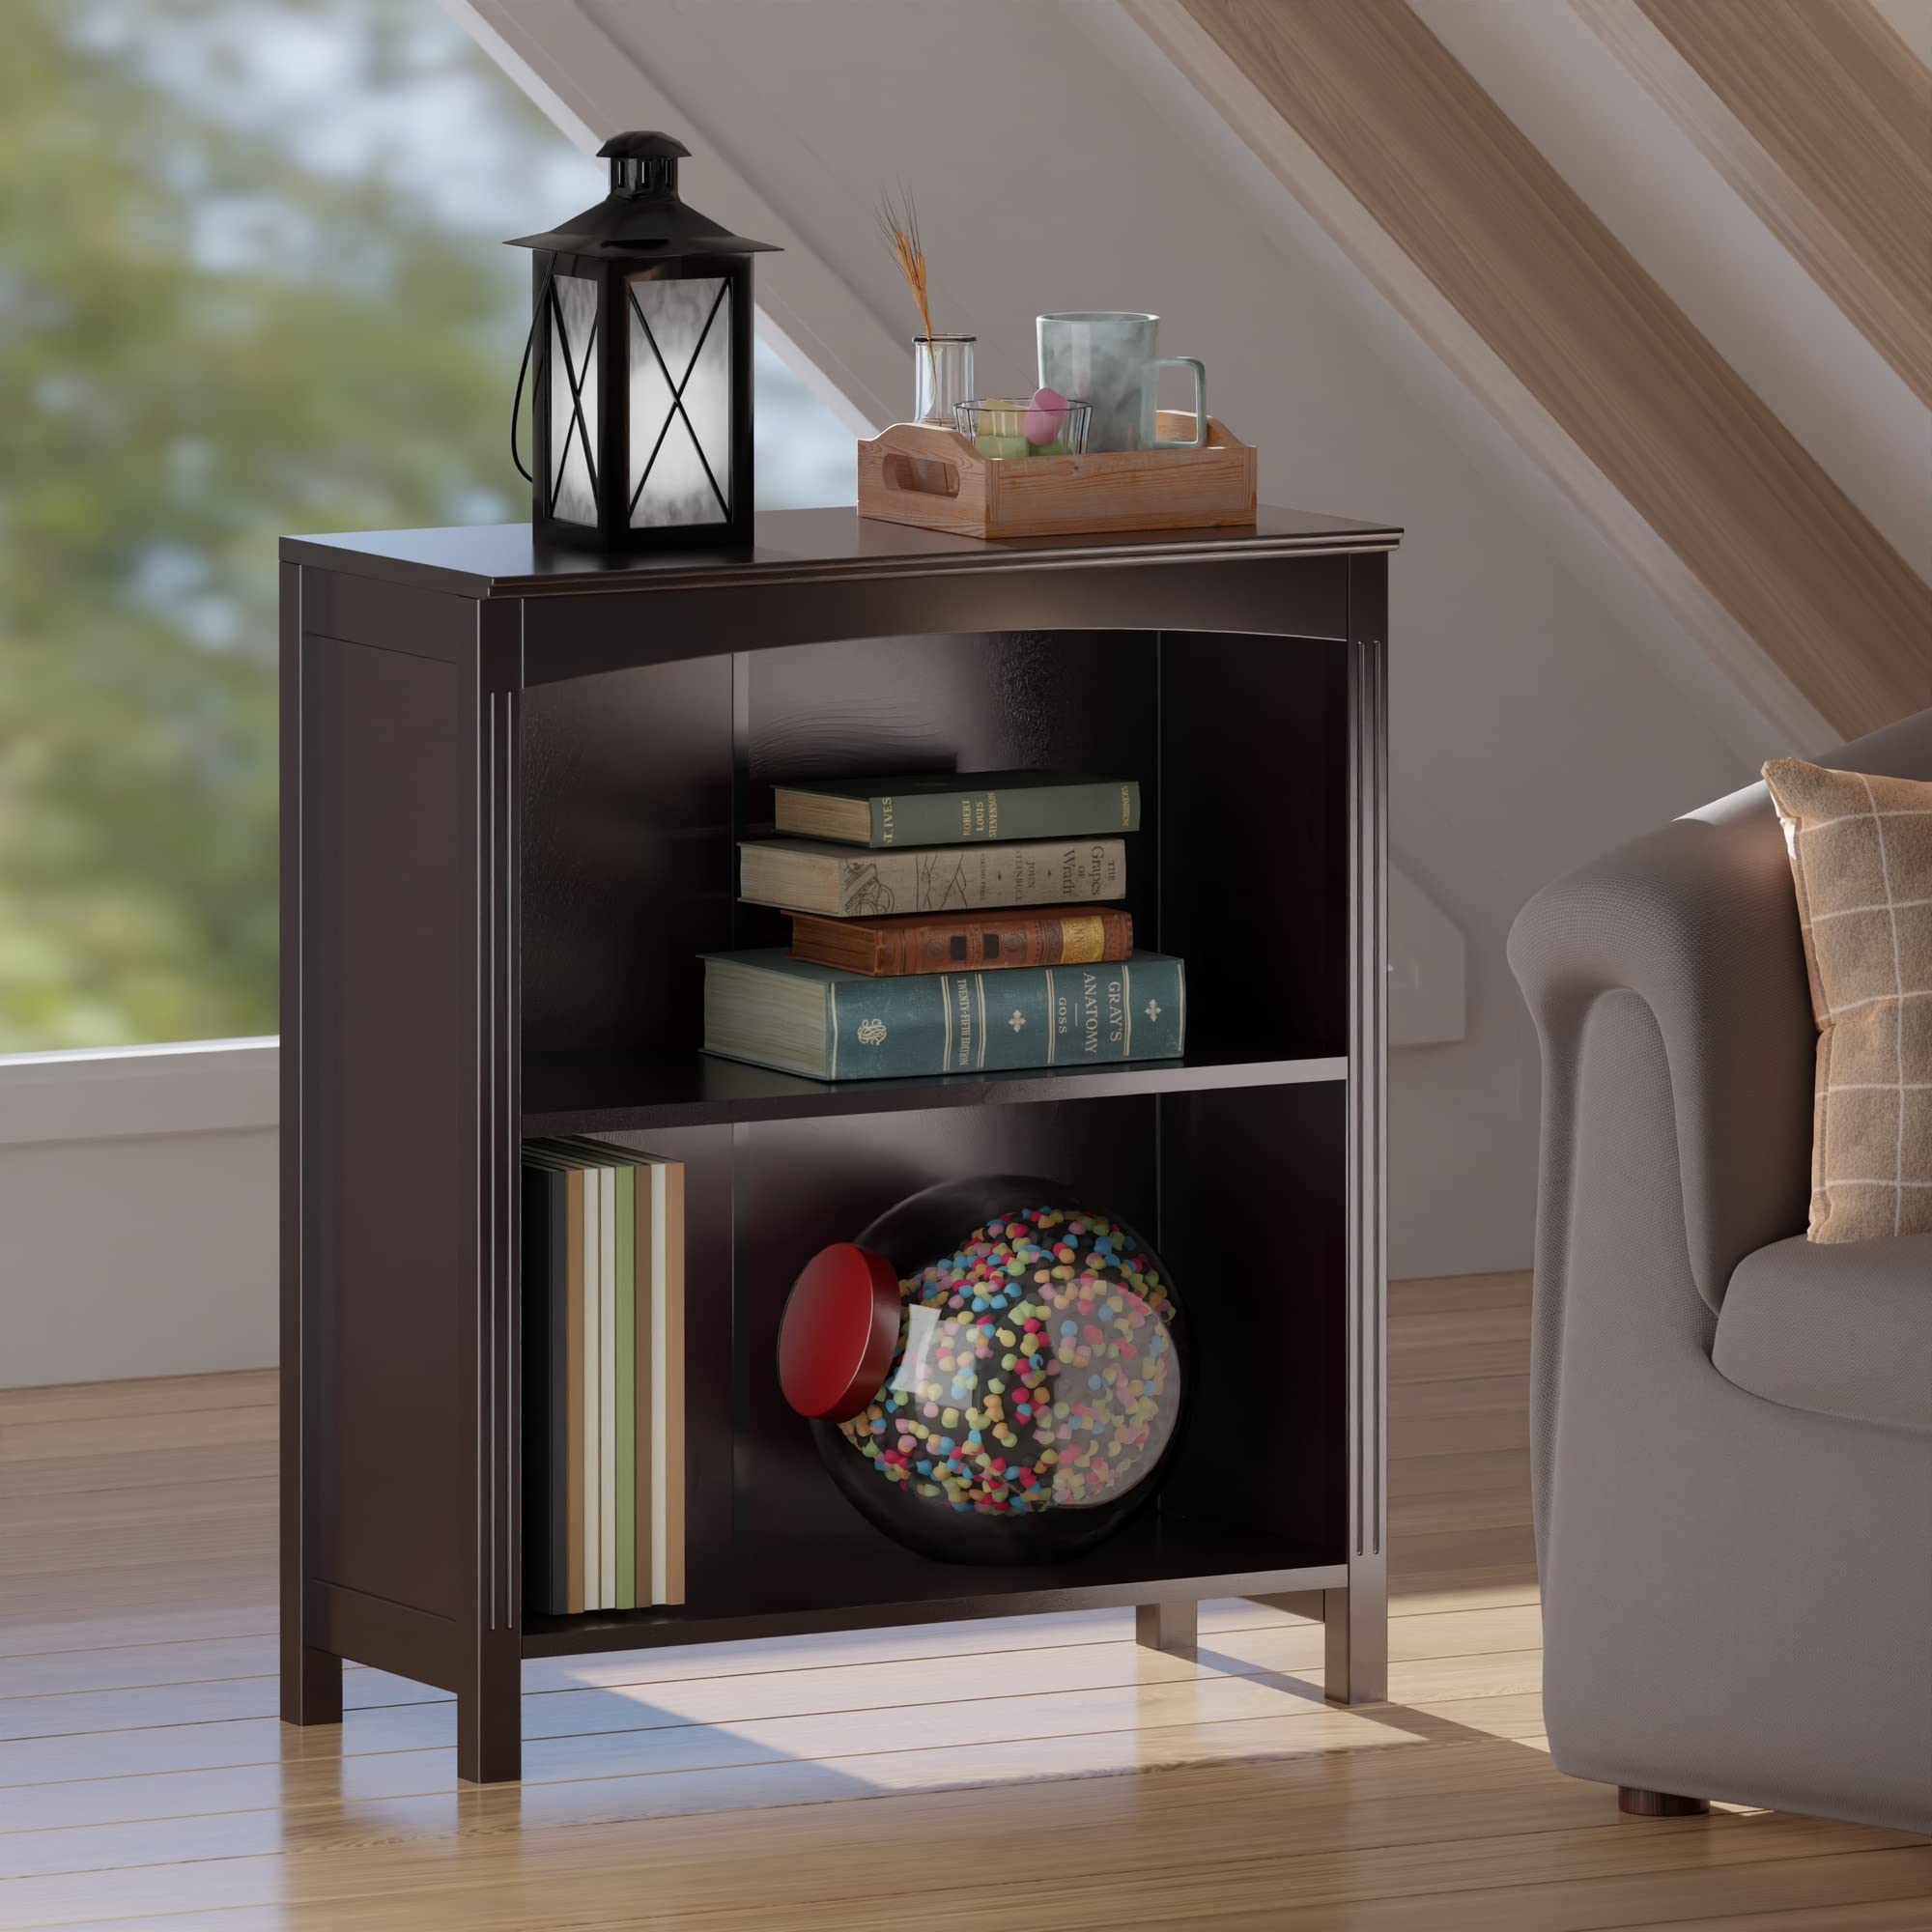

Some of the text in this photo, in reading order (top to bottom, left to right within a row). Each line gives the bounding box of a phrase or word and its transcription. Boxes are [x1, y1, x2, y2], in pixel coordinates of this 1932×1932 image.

[882, 796, 894, 828] IVES
[961, 799, 972, 836] ROBERT
[975, 801, 984, 832] LOUIS
[987, 792, 998, 838] STEVENSON
[1026, 860, 1036, 889] JOHN
[1063, 849, 1076, 895] Wrath
[1078, 866, 1086, 879] OF
[1089, 845, 1105, 896] Grapes
[1107, 860, 1116, 882] THE
[957, 979, 971, 1066] TWENTY-FIFTH EDITION
[1058, 997, 1067, 1035] GOSS
[1083, 972, 1098, 1055] ANATOMY
[1108, 980, 1122, 1042] GRAY'S
